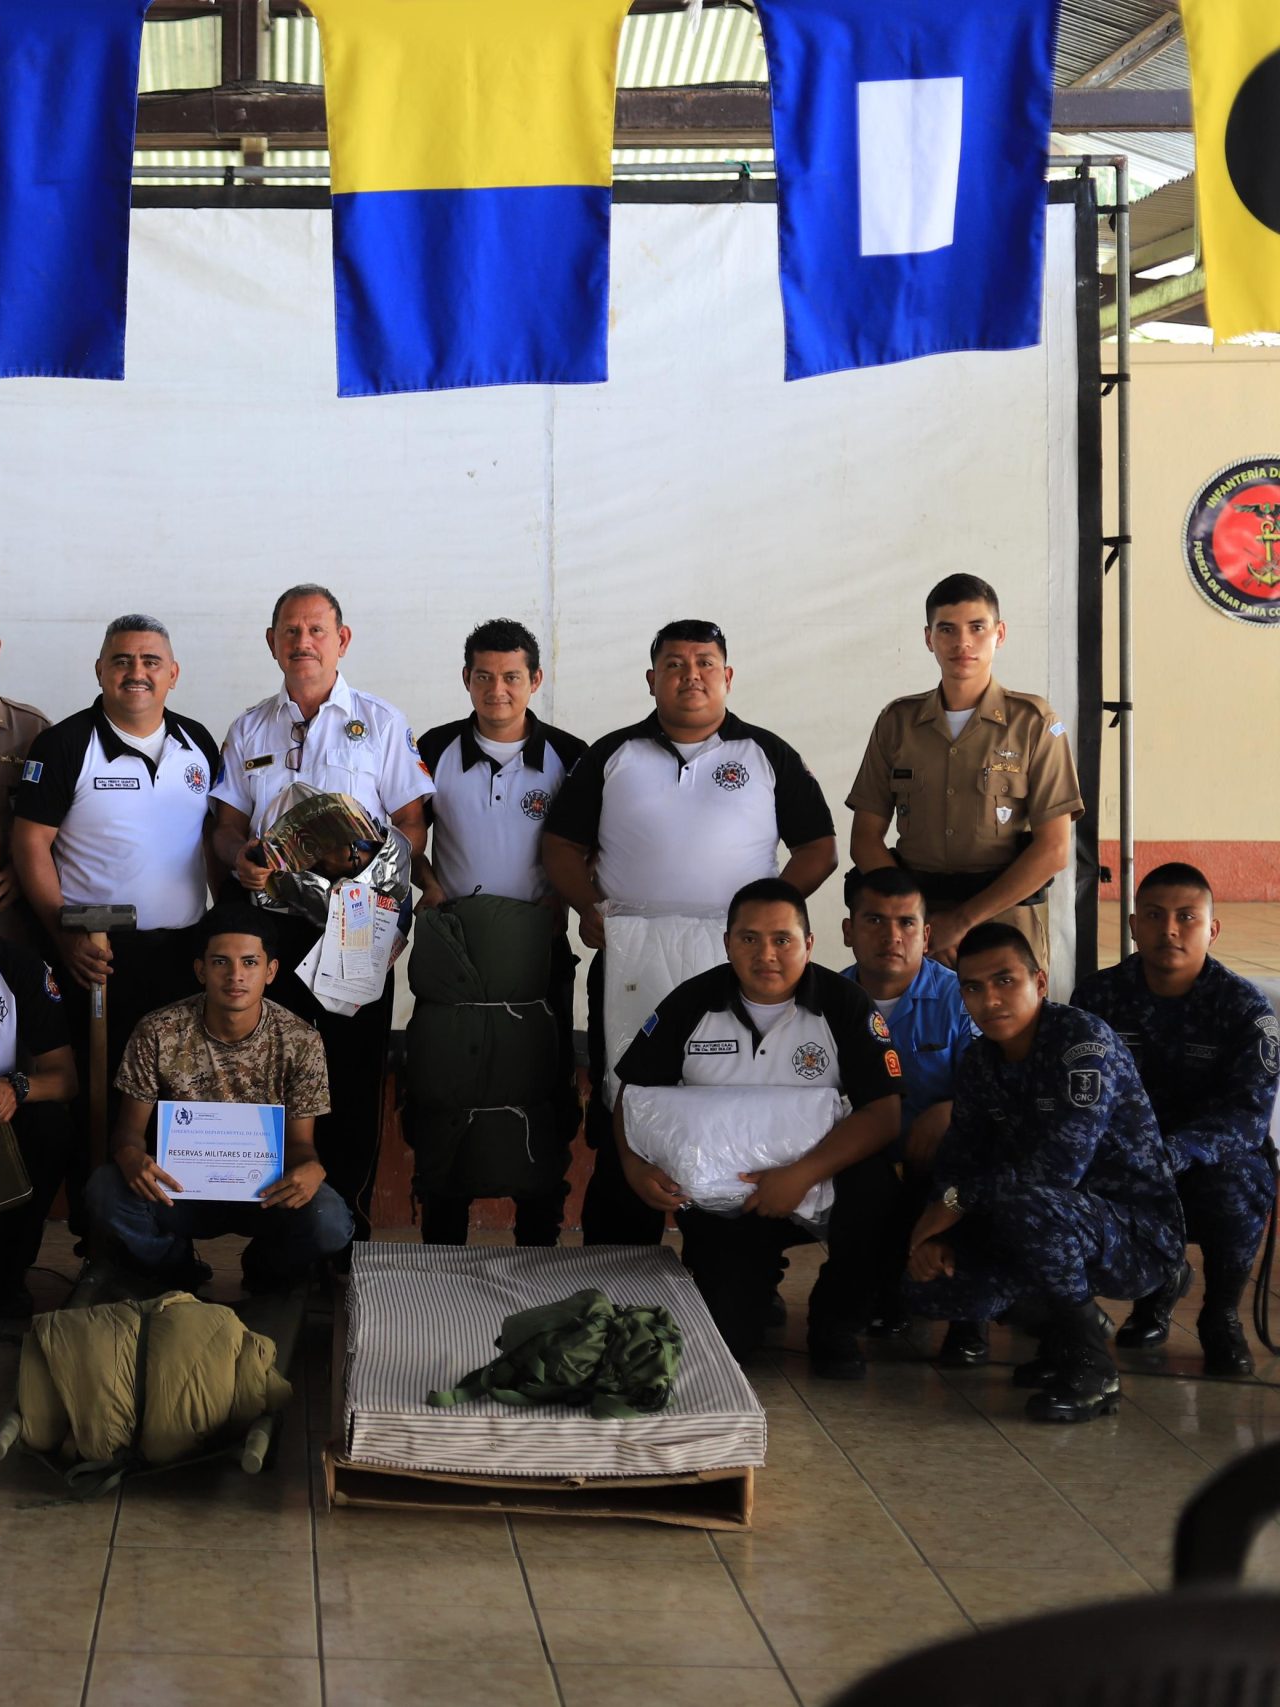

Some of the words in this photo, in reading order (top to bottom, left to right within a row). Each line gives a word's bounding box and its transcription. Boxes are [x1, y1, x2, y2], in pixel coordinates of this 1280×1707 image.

[1206, 466, 1267, 509] INFANTERÍA
[1192, 540, 1211, 581] FUERZA
[1207, 579, 1222, 594] DE
[1218, 590, 1241, 609] MAR
[1240, 602, 1266, 617] PARA
[351, 901, 363, 909] FIRE
[1065, 1044, 1105, 1063] GUATEMALA
[1074, 1093, 1093, 1102] CNC
[168, 1149, 203, 1157] RESERVAS
[204, 1150, 241, 1158] MILITARES
